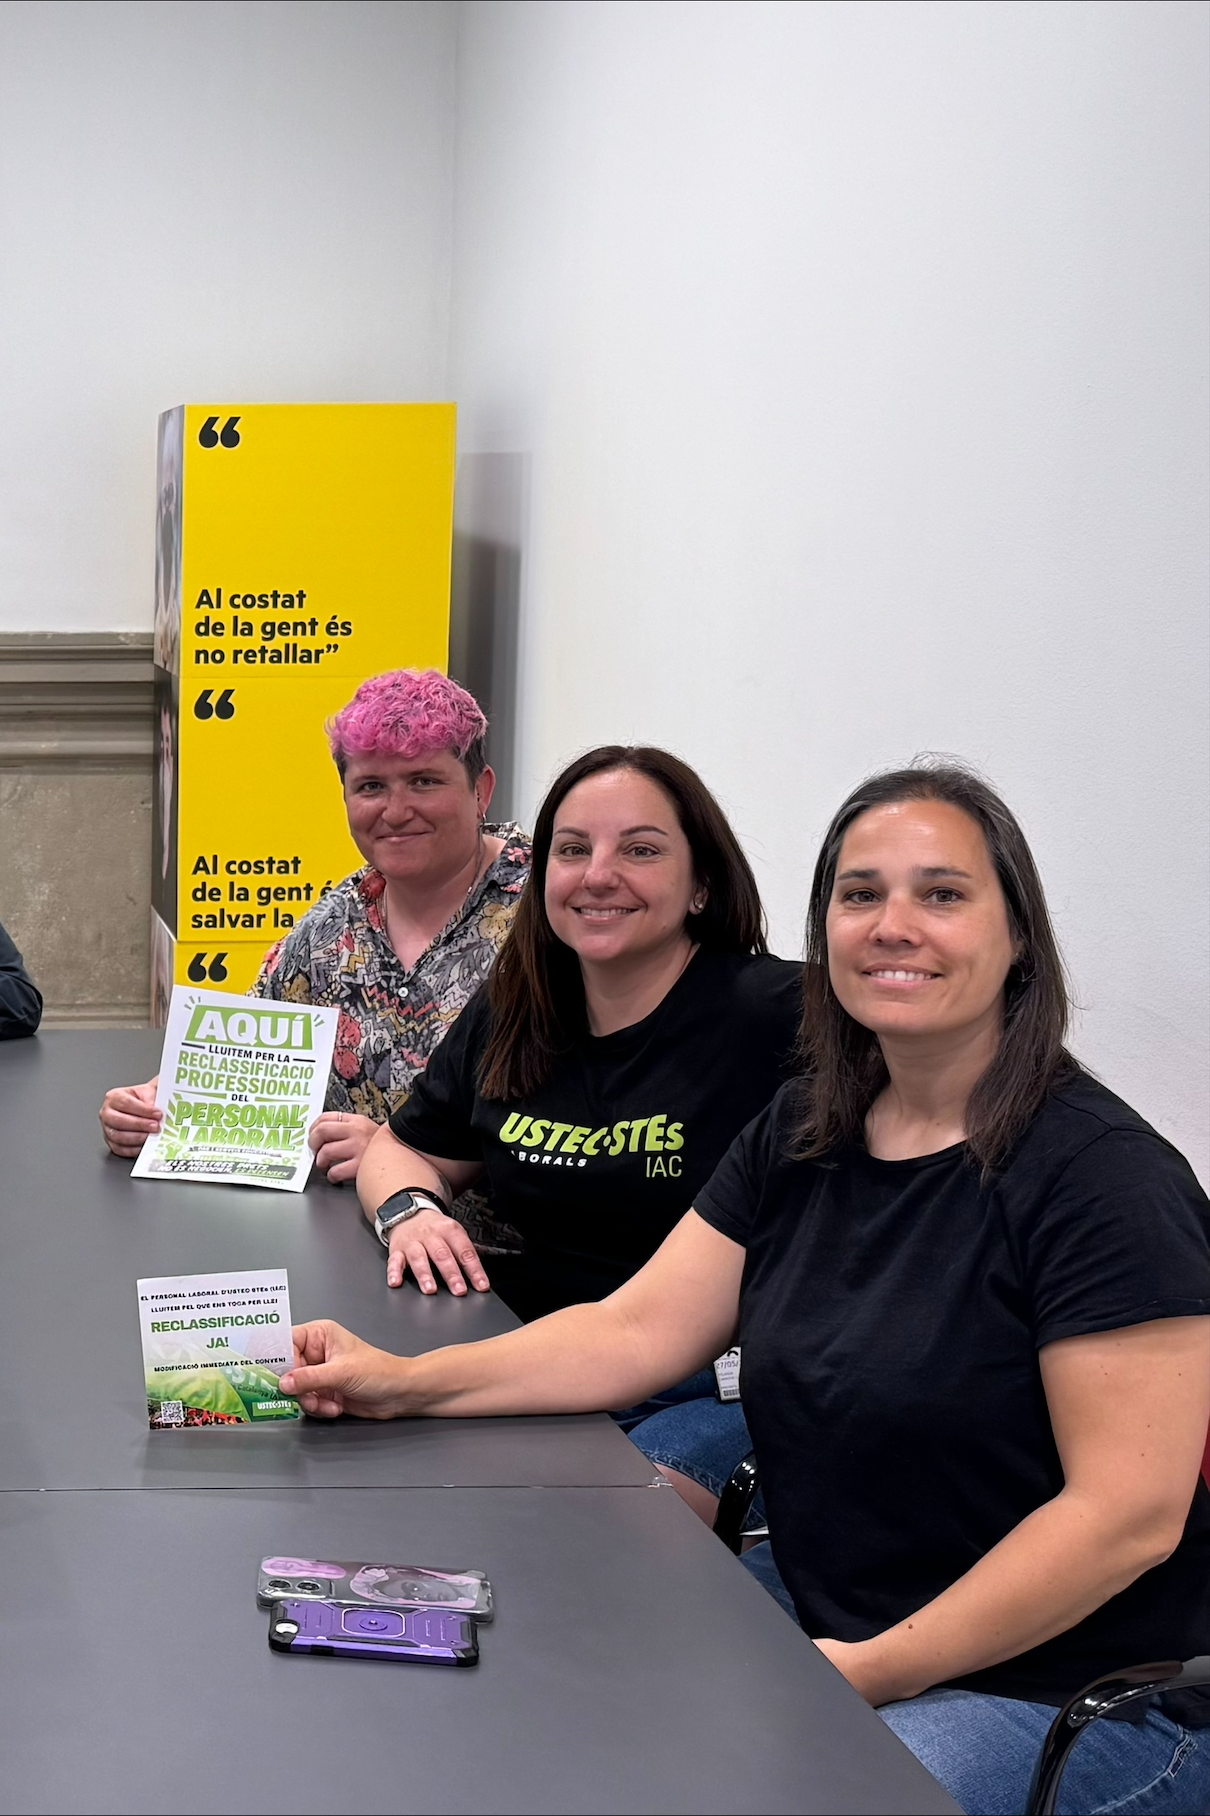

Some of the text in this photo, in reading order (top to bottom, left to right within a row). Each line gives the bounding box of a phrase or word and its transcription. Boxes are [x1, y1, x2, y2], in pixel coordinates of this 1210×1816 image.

[195, 588, 306, 609] Al costat
[195, 615, 353, 641] de la gent és
[194, 643, 339, 664] no retallar”
[192, 855, 301, 875] Al costat
[192, 881, 221, 902] de
[229, 881, 249, 902] la
[257, 883, 313, 906] gent
[192, 908, 294, 929] salvar la
[195, 1010, 305, 1047] AQUÍ
[209, 1045, 290, 1063] LLUITEM PER LA
[178, 1050, 314, 1080] RECLASSIFICACIÓ
[175, 1068, 311, 1096] PROFESSIONAL
[231, 1093, 249, 1102] DEL
[175, 1101, 305, 1129] PERSONAL
[180, 1126, 297, 1150] LABORAL
[510, 1150, 683, 1178] BORALS IAC
[188, 1290, 219, 1298] LABORAL
[151, 1304, 180, 1313] LLUITEM
[151, 1310, 280, 1333] RECLASSIFICACIÓ
[206, 1336, 229, 1349] JA!
[153, 1363, 199, 1372] MODIFICACIÓ
[200, 1361, 238, 1369] IMMEDIATA
[255, 1357, 286, 1365] CONVENI
